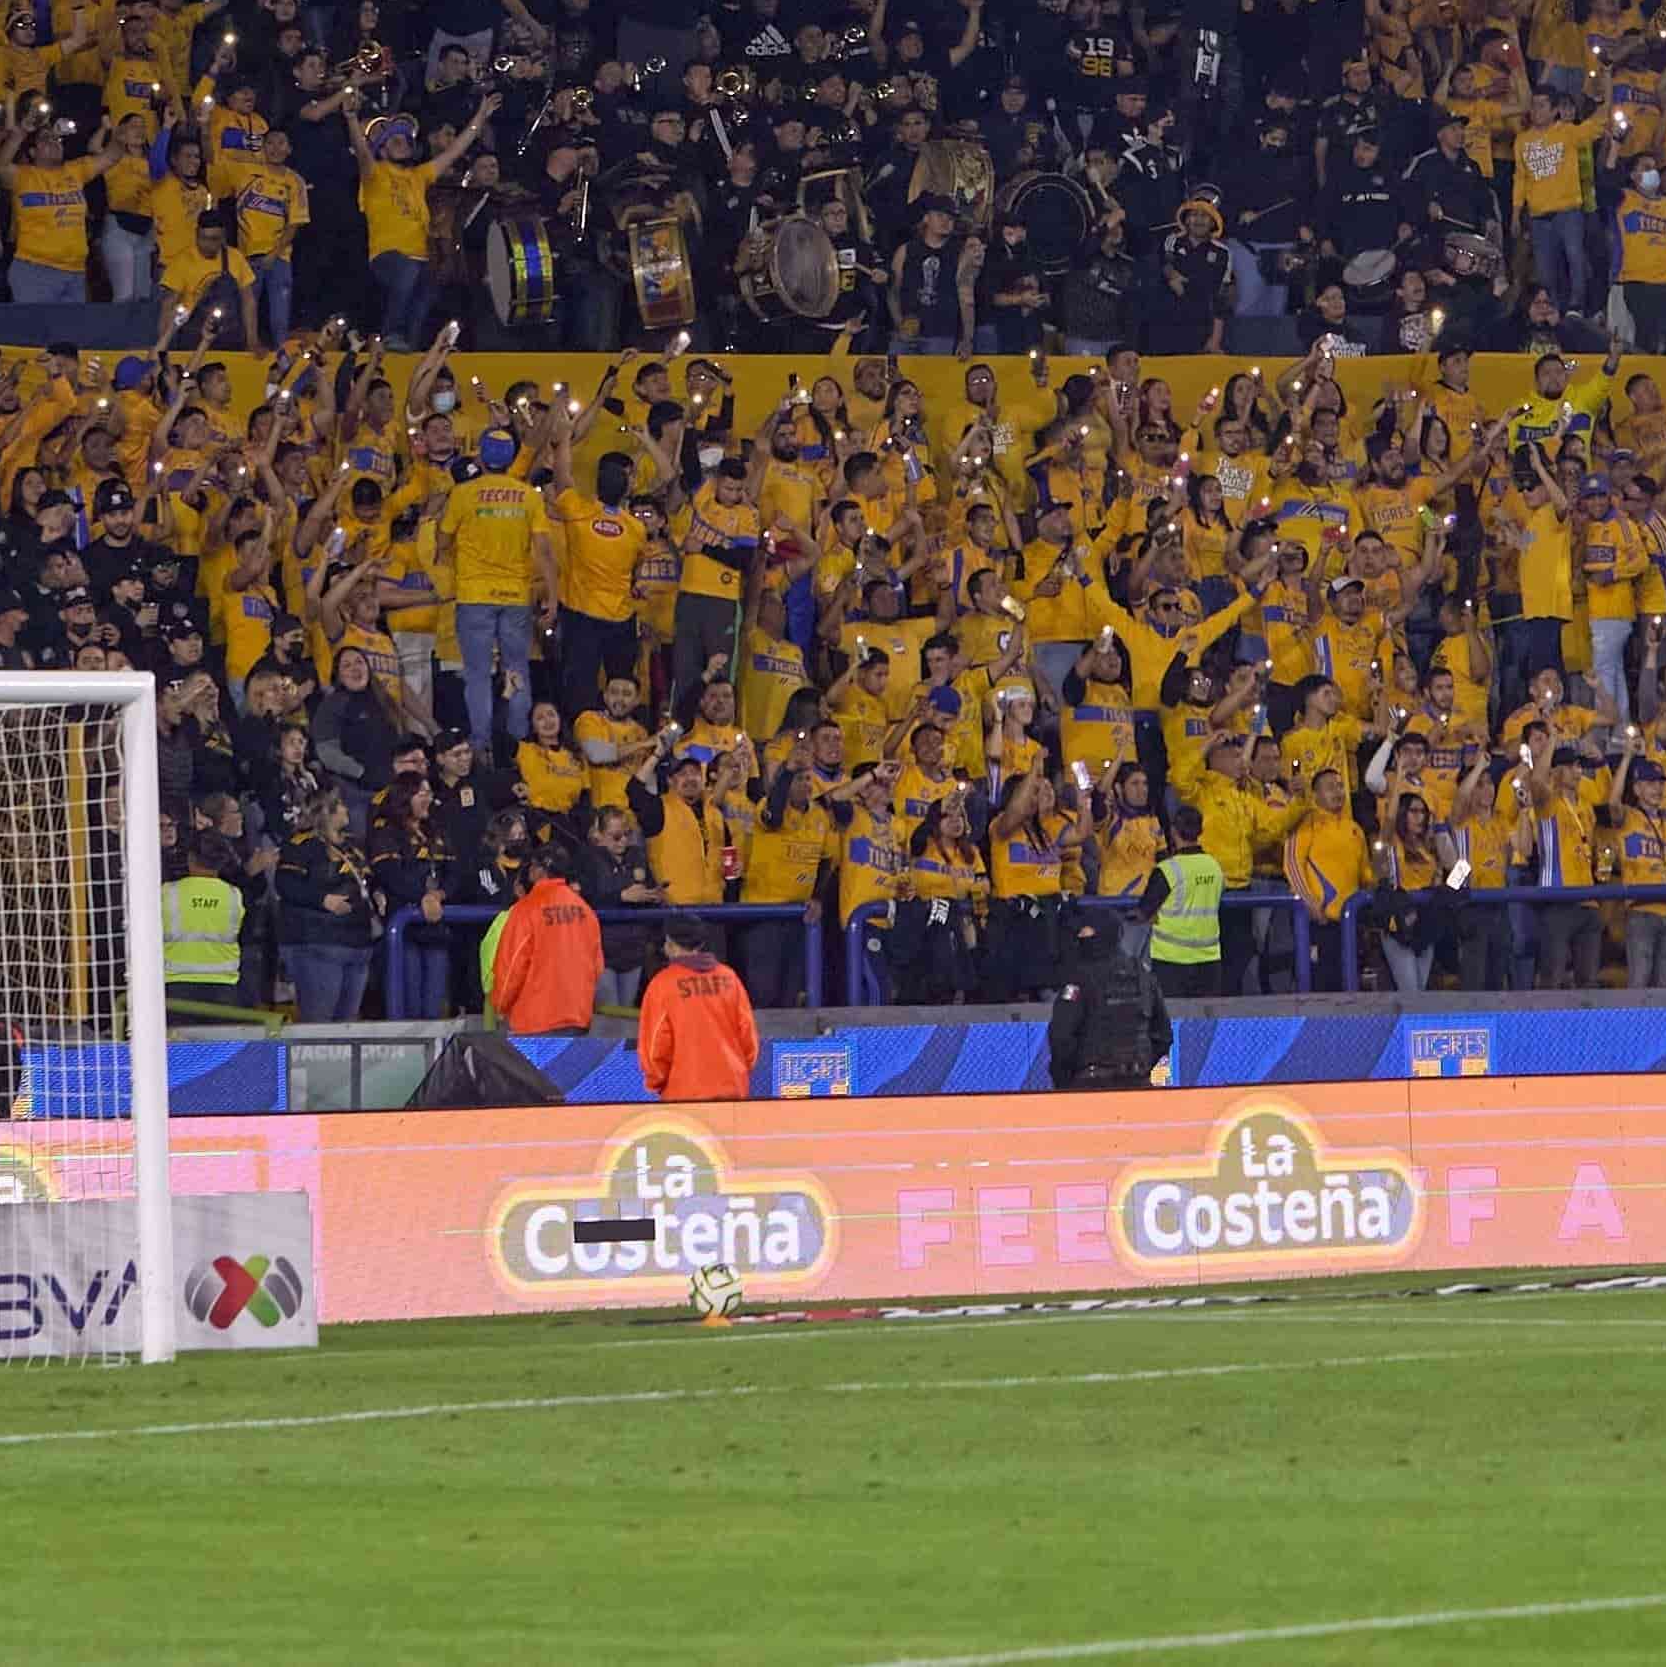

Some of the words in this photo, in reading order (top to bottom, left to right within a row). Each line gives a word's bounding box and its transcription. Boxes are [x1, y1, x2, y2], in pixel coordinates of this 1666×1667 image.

[1084, 37, 1114, 57] 19
[192, 898, 219, 909] STAFF
[543, 905, 587, 926] STAFF
[677, 974, 731, 998] STAFF
[1412, 1034, 1489, 1057] TIGRES
[1240, 1127, 1297, 1177] La
[636, 1146, 695, 1198] La
[1143, 1174, 1390, 1250] Costeña
